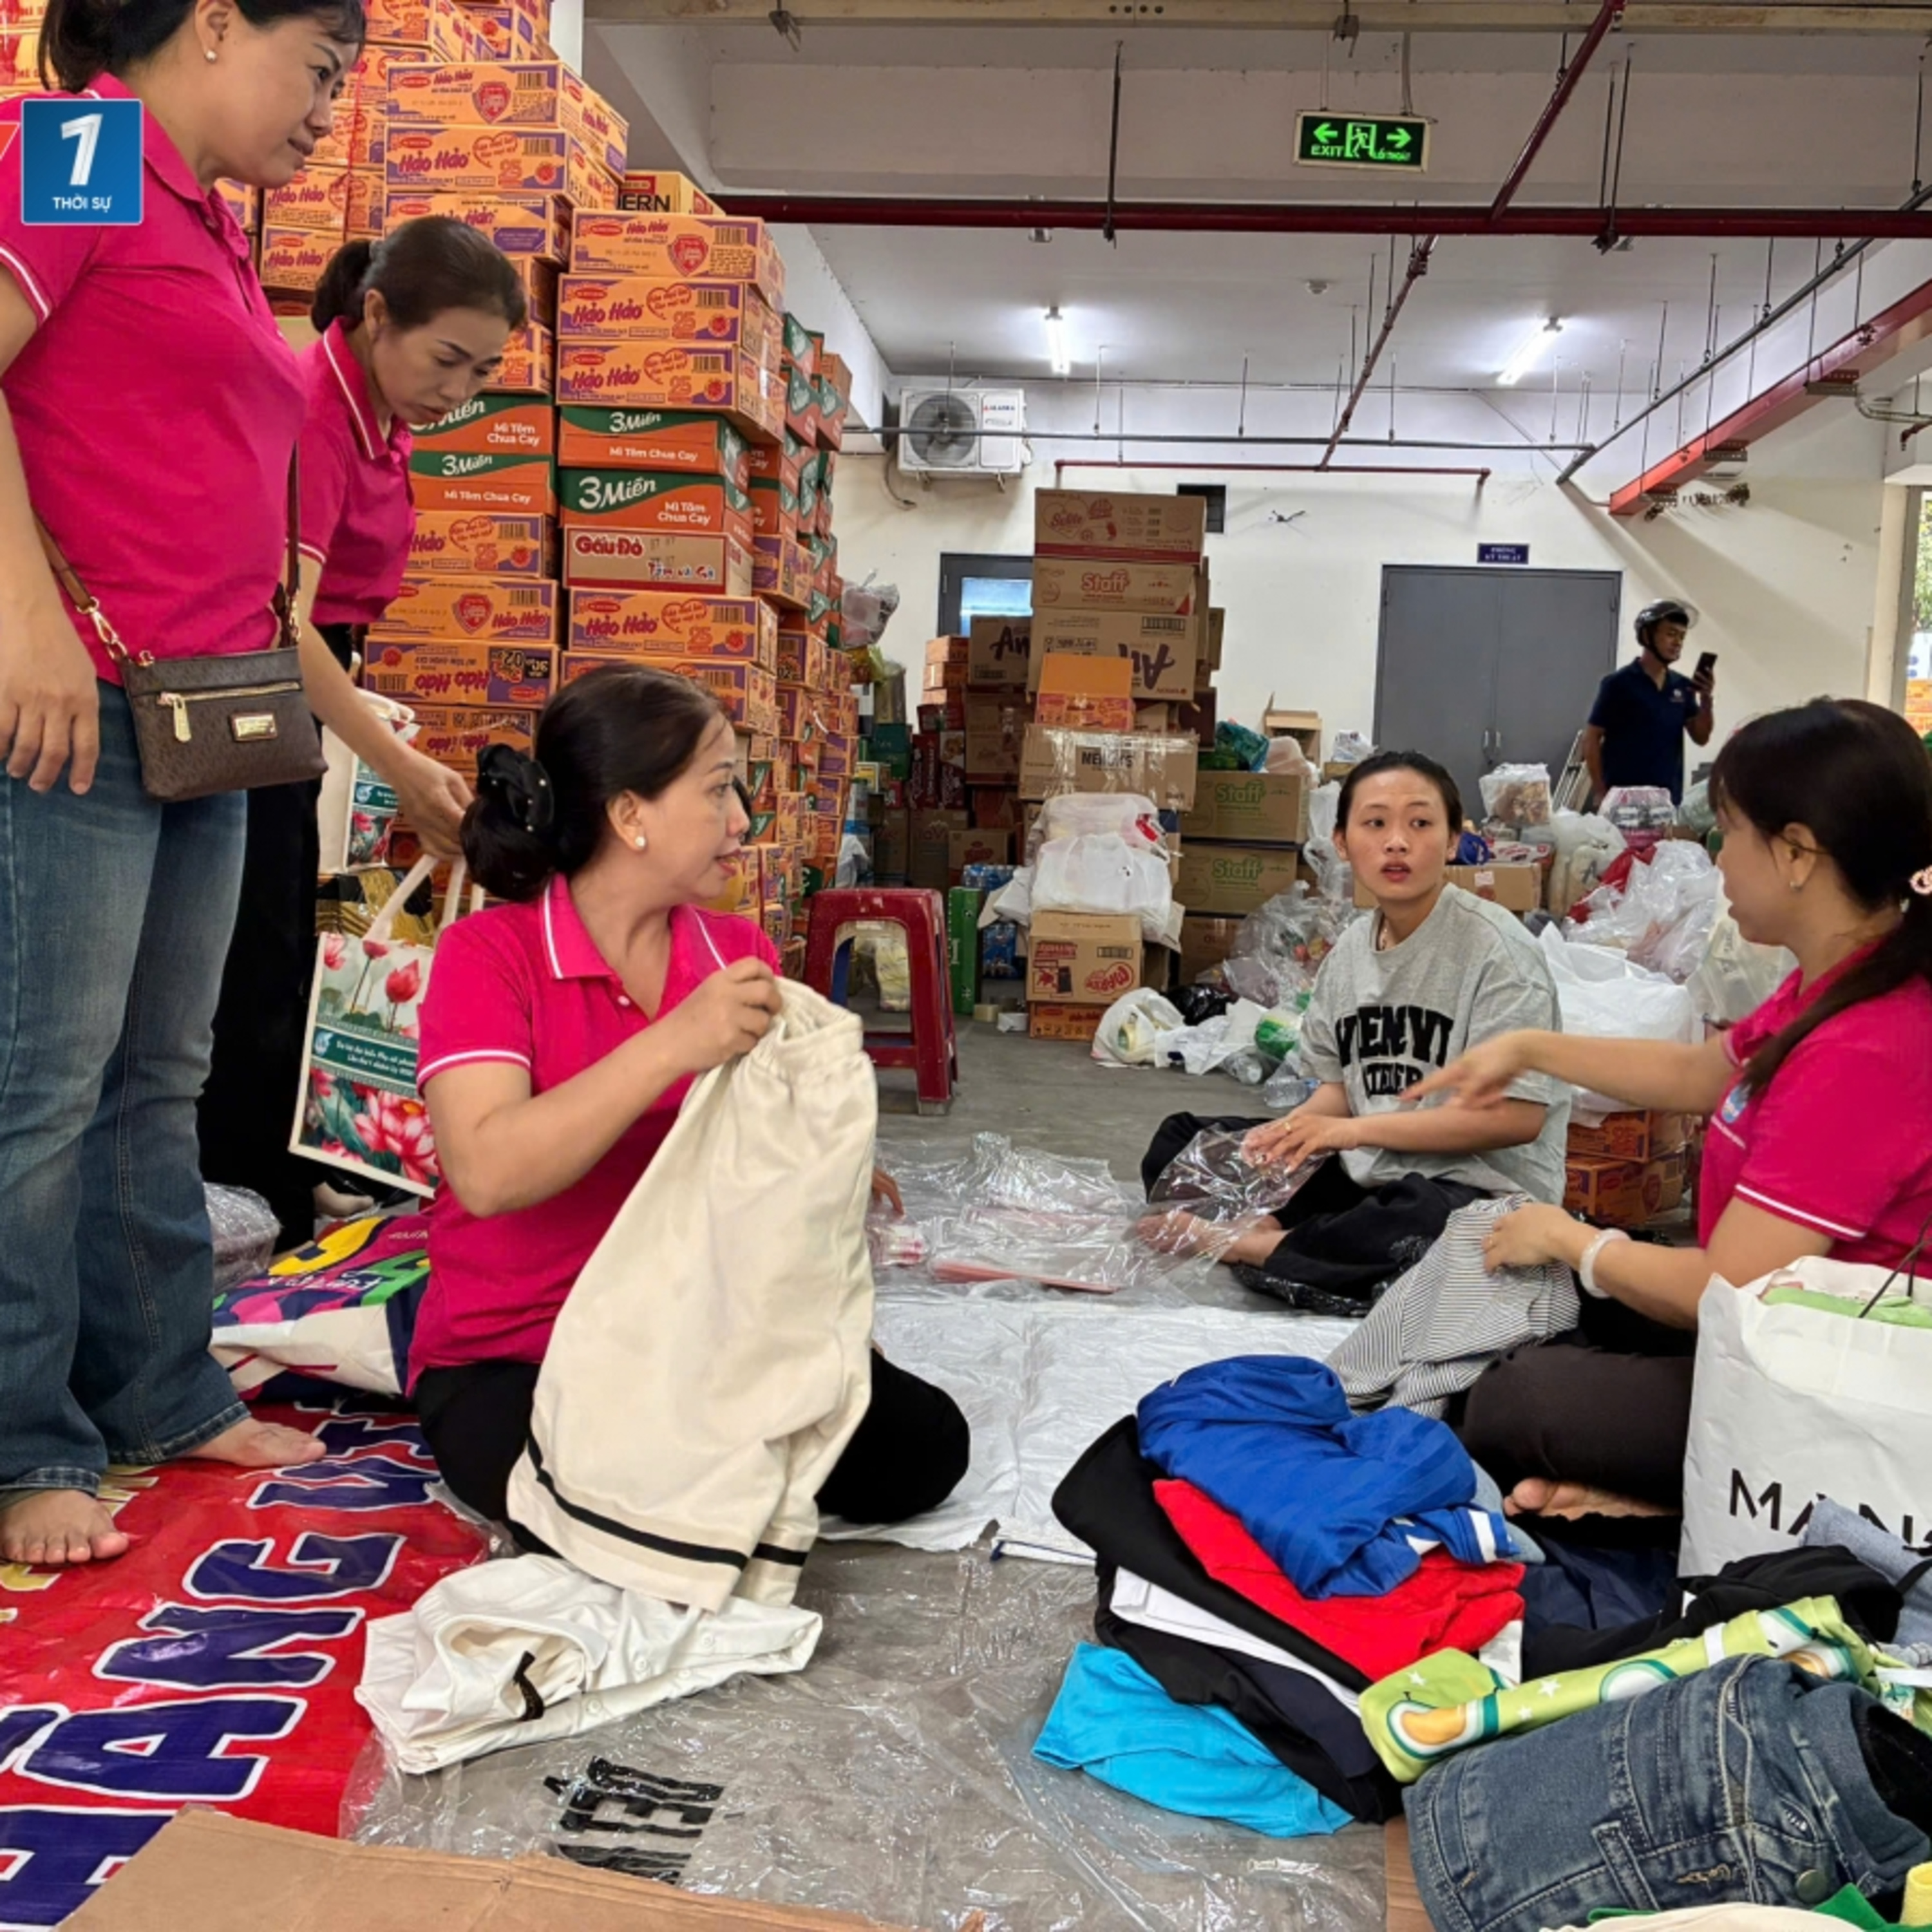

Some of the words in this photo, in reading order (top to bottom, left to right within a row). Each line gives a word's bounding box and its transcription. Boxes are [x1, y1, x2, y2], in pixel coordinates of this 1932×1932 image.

[399, 151, 432, 173] Hảo
[435, 147, 469, 170] Hảo
[1311, 145, 1344, 156] EXIT
[616, 194, 670, 211] ERN
[573, 302, 606, 323] Hảo
[609, 298, 643, 321] Hảo
[572, 368, 603, 389] Hảo
[607, 363, 640, 386] Hảo
[487, 433, 516, 444] Chua
[518, 433, 540, 447] Cay
[649, 448, 676, 460] Chua
[677, 450, 698, 462] Cay
[483, 491, 509, 502] Chua
[511, 493, 531, 505] Cay
[665, 502, 680, 512] Mì
[657, 513, 687, 524] Chua
[688, 514, 711, 526] Cay
[575, 535, 613, 556] Gấu
[616, 537, 643, 556] Đỏ
[1081, 569, 1130, 594] Staff
[585, 616, 620, 636] Hảo
[622, 612, 658, 634] Hảo
[1215, 780, 1266, 804] Staff
[1211, 855, 1264, 878] Staff
